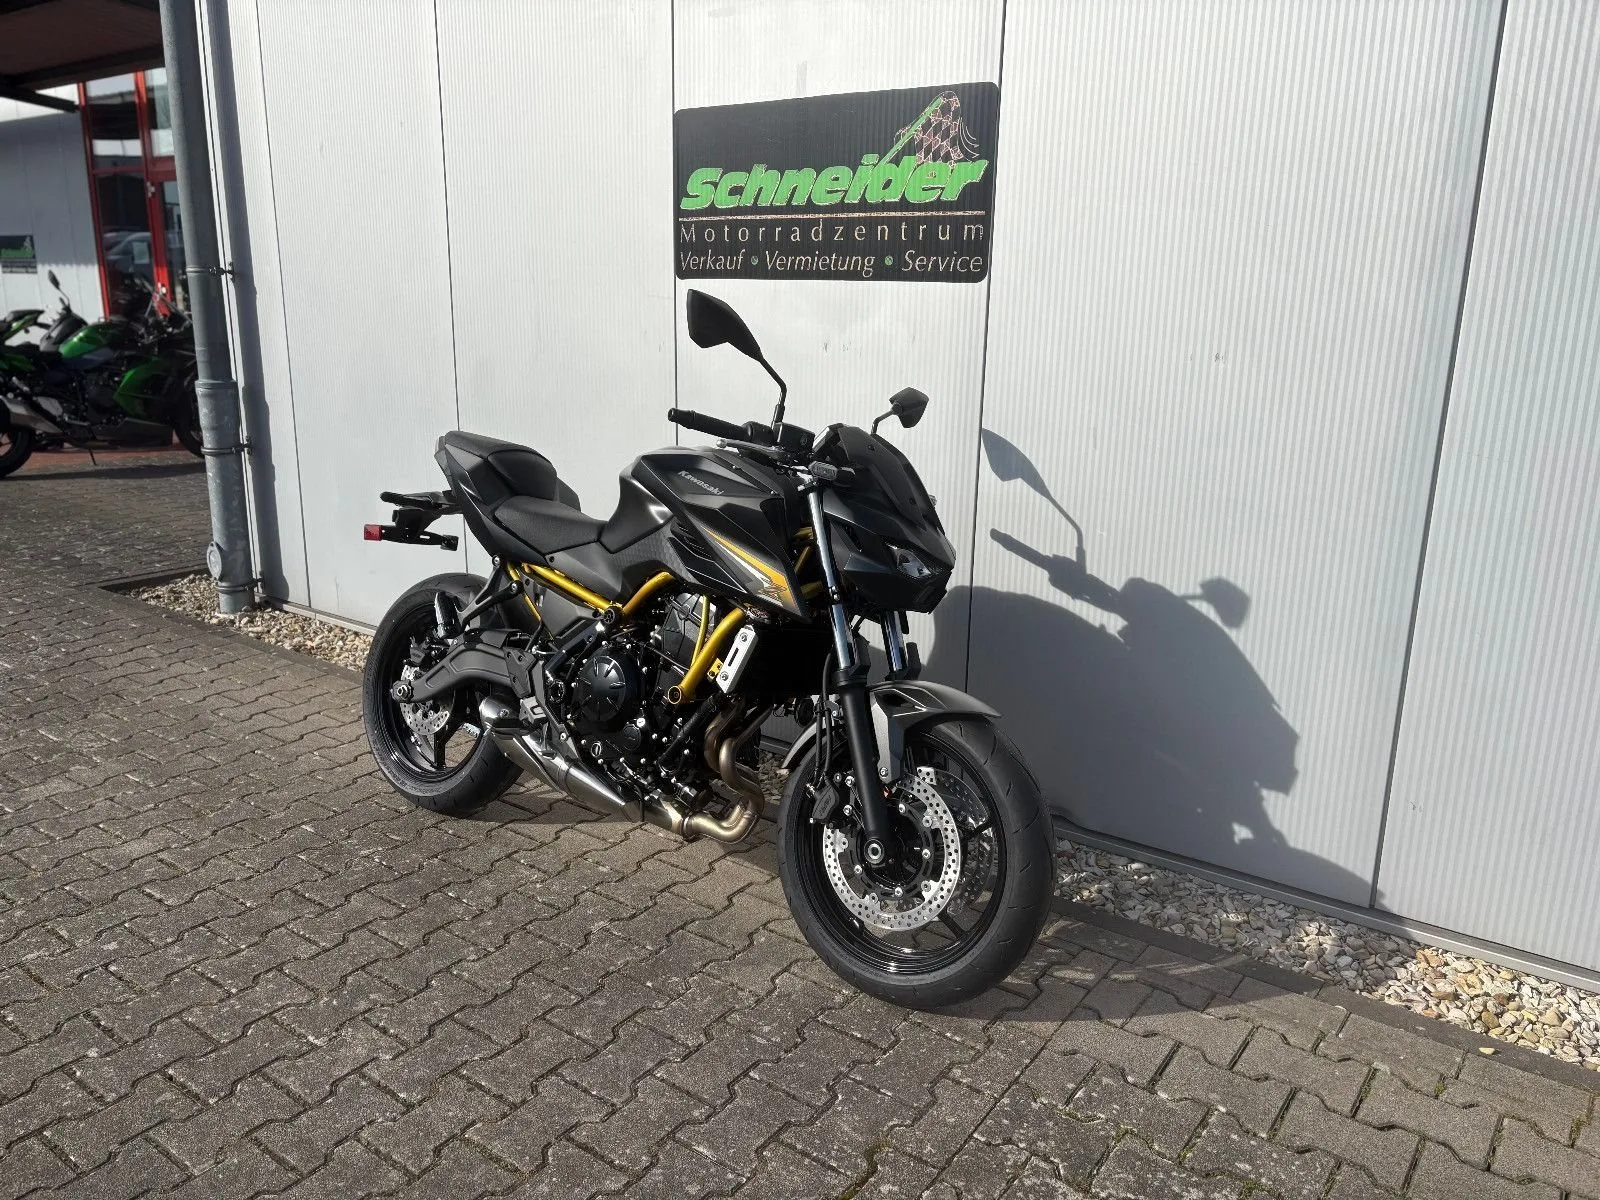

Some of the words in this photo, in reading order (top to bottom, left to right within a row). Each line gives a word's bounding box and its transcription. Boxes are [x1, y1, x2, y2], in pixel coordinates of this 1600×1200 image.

[680, 219, 984, 243] Motorradzentrum
[680, 249, 745, 271] Verkauf
[765, 250, 875, 277] Vermietung
[902, 250, 983, 273] Service
[677, 470, 724, 495] Kawasaki
